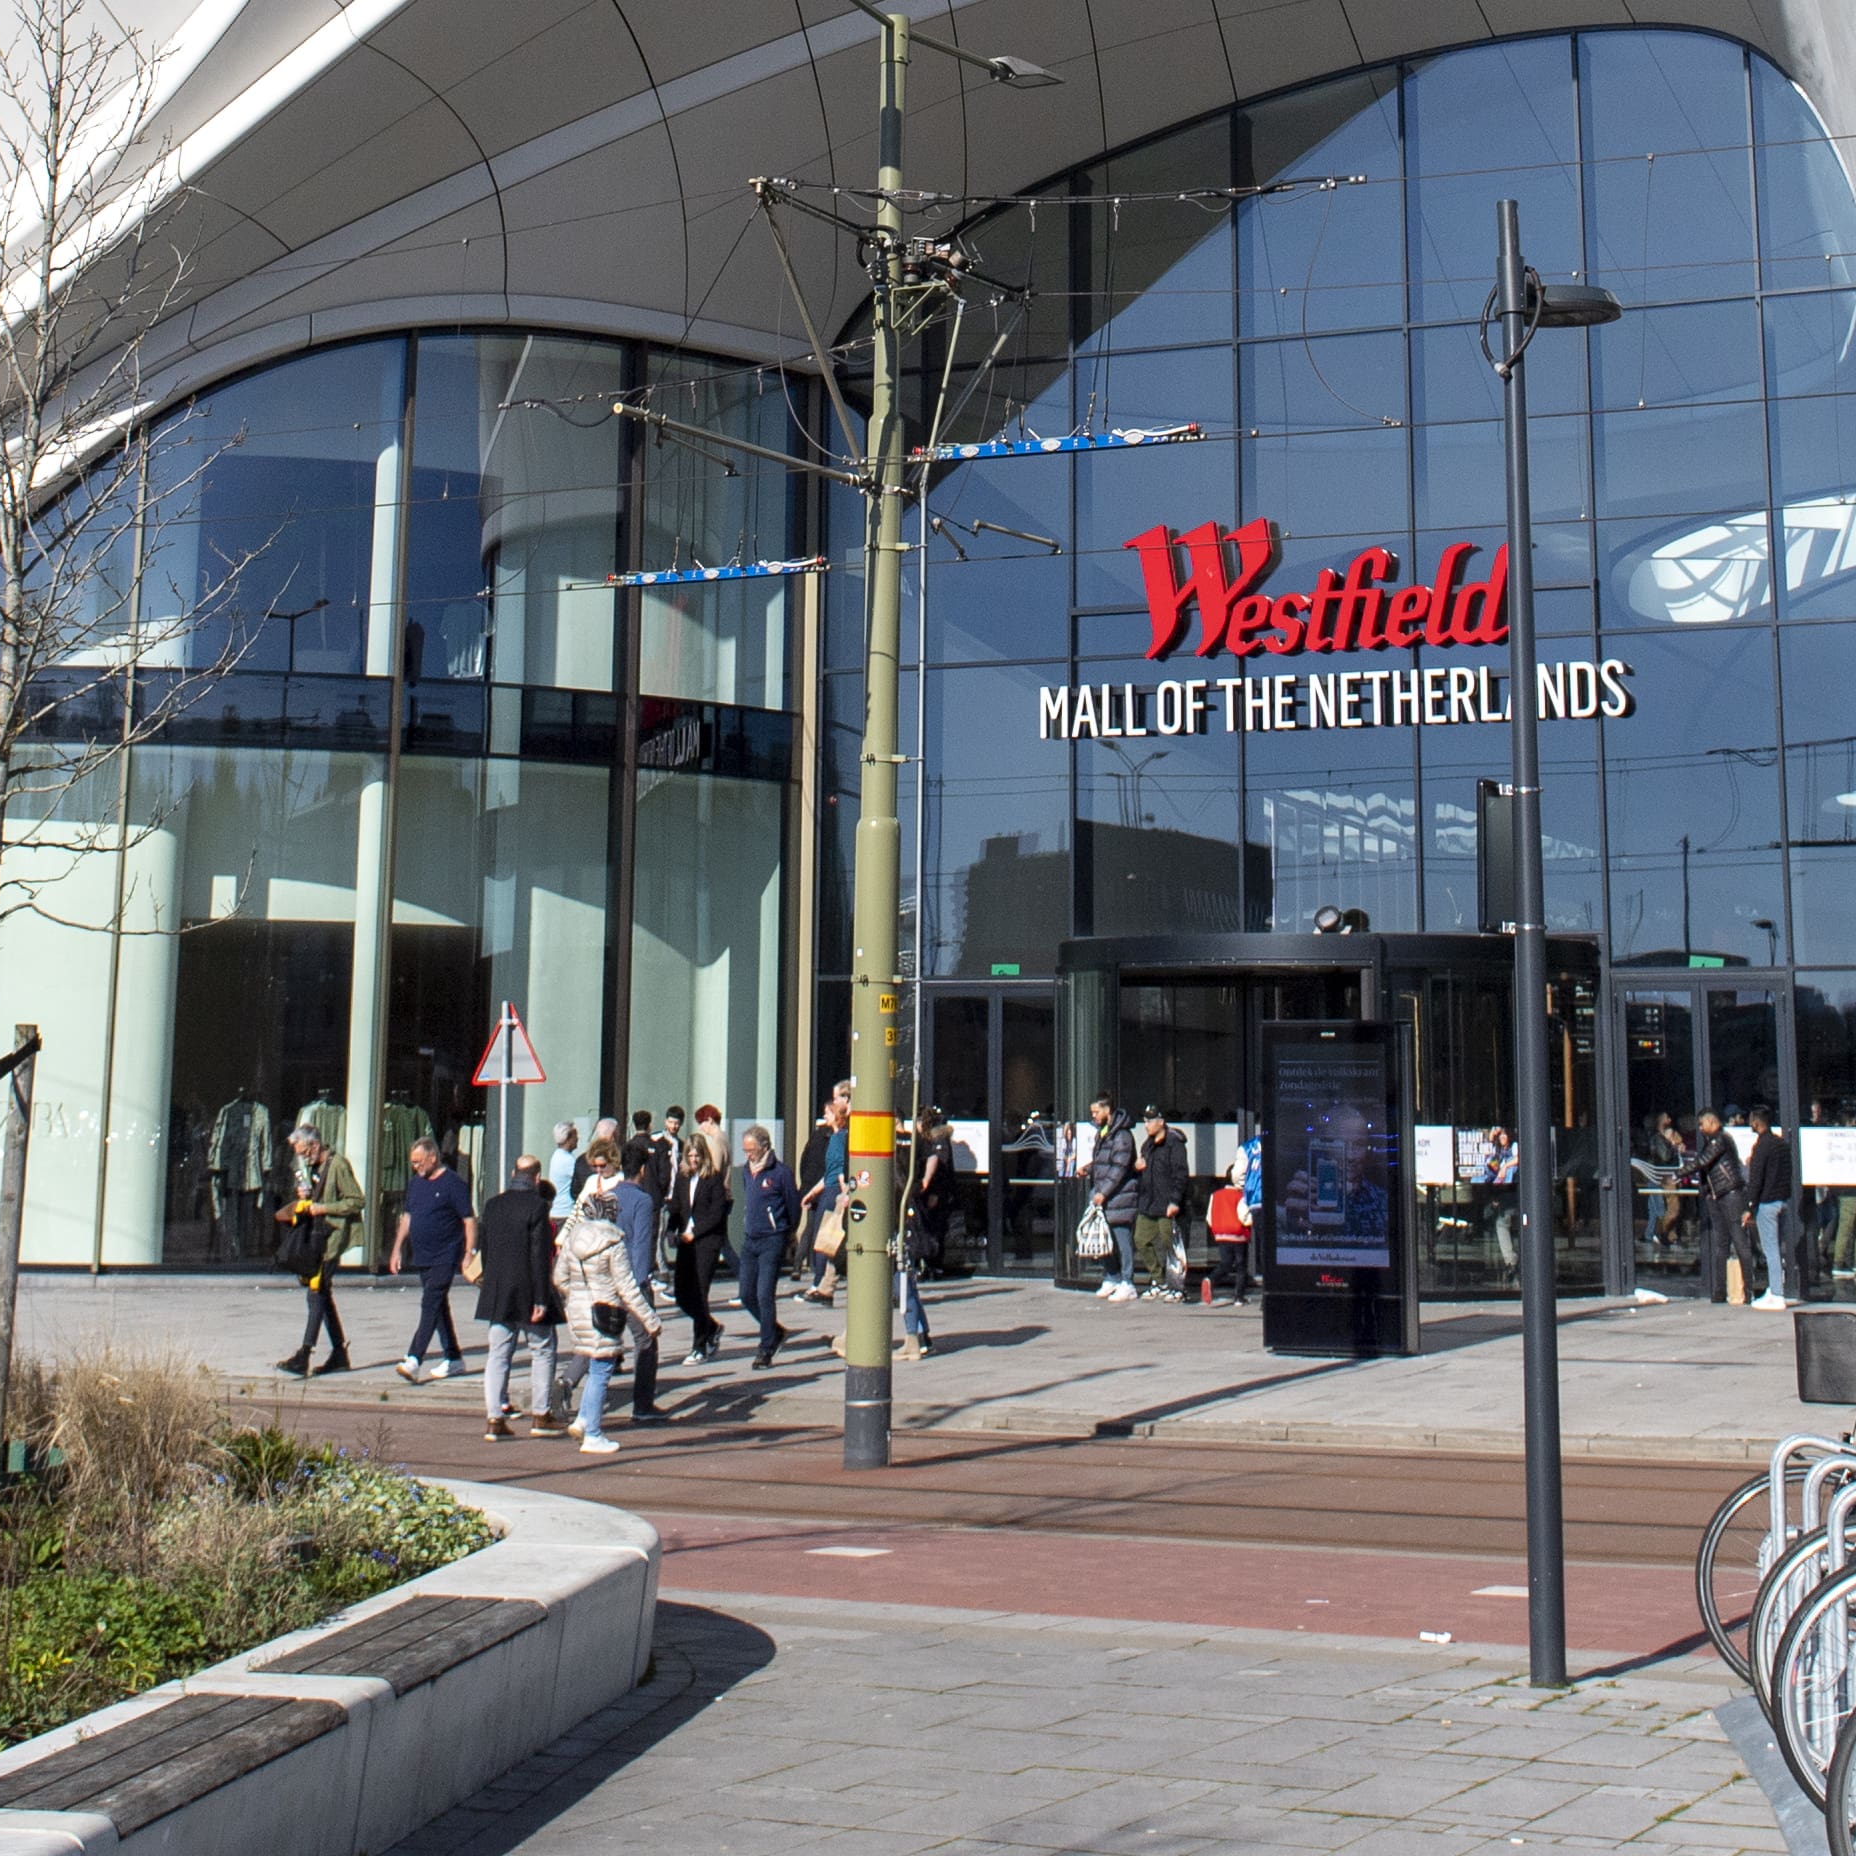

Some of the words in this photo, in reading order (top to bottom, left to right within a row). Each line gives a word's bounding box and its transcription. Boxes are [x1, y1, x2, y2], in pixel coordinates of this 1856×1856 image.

[1124, 518, 1510, 659] Westfield
[1039, 683, 1146, 739] MALL
[1156, 679, 1206, 734] OF
[1217, 675, 1295, 731] THE
[1308, 659, 1628, 729] NETHERLNDS
[881, 997, 896, 1009] M7
